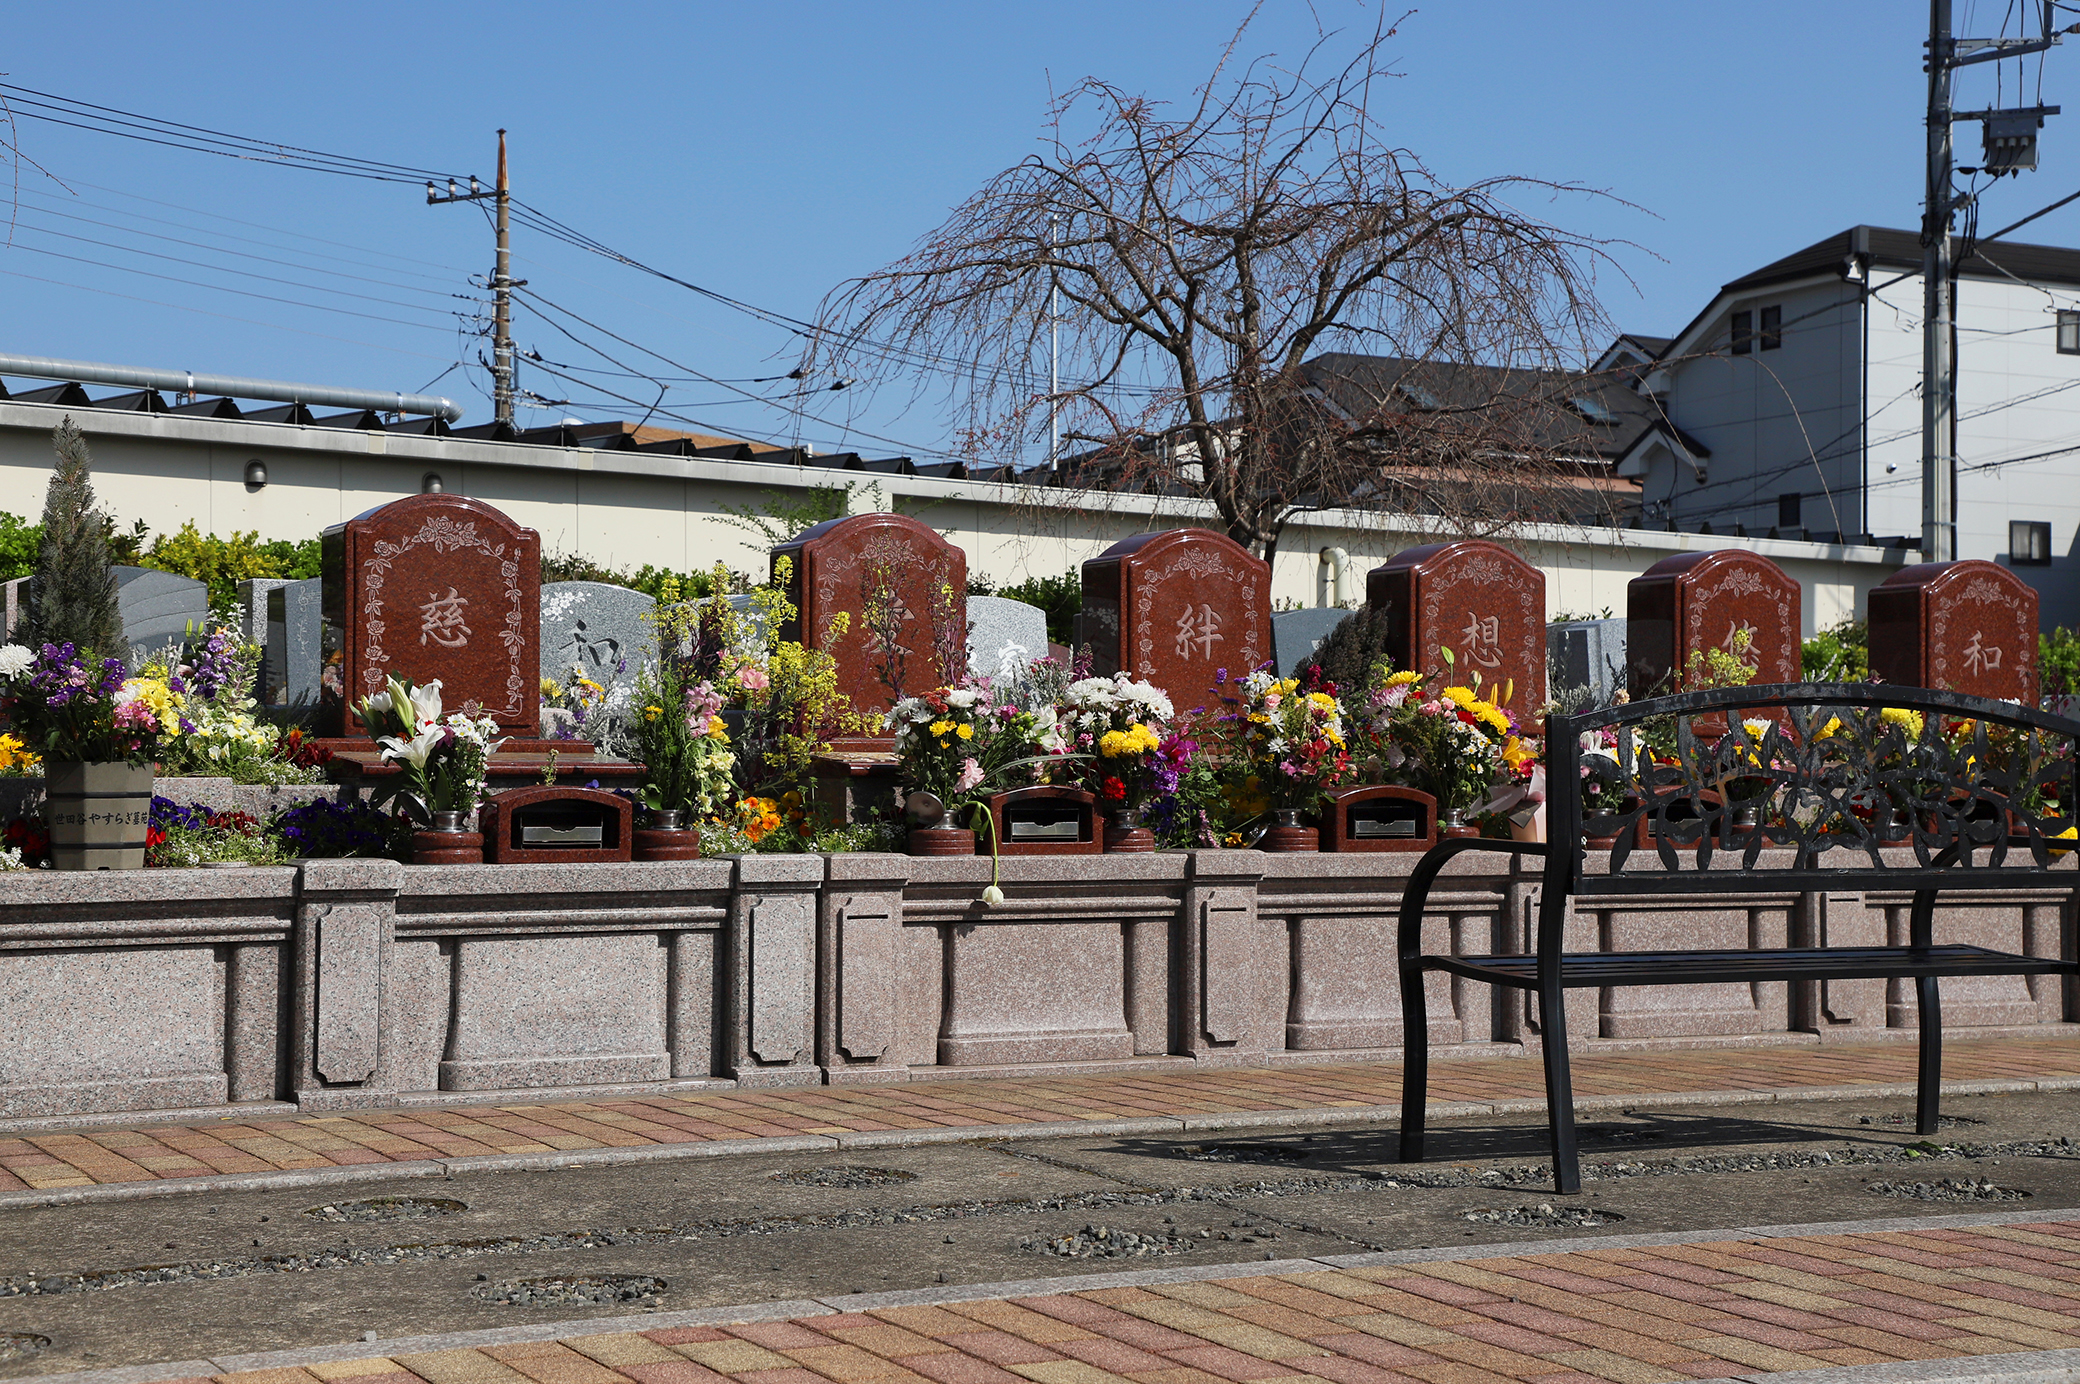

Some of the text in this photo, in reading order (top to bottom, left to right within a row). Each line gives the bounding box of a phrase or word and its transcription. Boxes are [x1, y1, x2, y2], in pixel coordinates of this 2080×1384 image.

[419, 583, 472, 648] 慈
[1175, 603, 1225, 661] 絆
[1460, 611, 1504, 668] 想
[1962, 629, 2003, 677] 和
